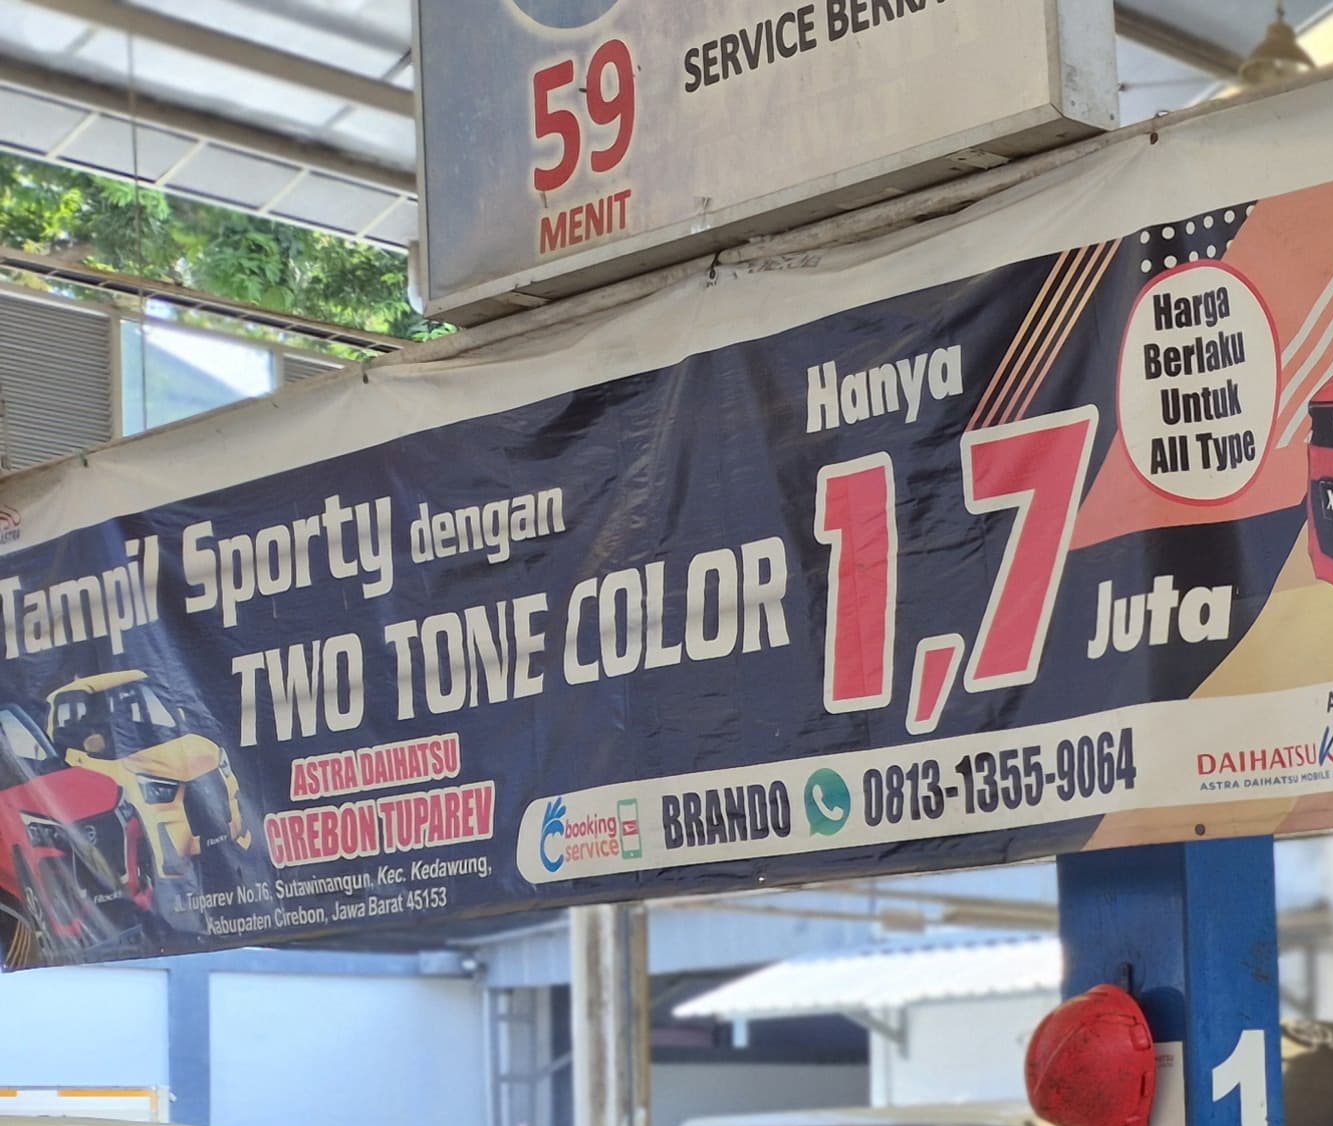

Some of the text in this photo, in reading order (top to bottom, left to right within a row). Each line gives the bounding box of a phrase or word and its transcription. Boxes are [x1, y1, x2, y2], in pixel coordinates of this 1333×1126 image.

[684, 0, 946, 93] SERVICE BER
[533, 39, 635, 191] 59
[539, 189, 632, 254] MENIT
[1153, 287, 1230, 331] Harga
[1143, 331, 1245, 380] Berlaku
[805, 344, 964, 433] Hanya
[1160, 379, 1242, 425] Untuk
[1150, 430, 1256, 475] All Type
[0, 487, 567, 660] Tampil Sporty dengan
[814, 404, 1099, 736] 1,7
[231, 535, 792, 747] TWO TONE COLOR
[1087, 575, 1232, 660] Juta
[292, 737, 458, 798] ASTRA DAIHATSU
[662, 727, 1137, 850] BRANDO 0813-1355-9064
[1197, 744, 1316, 775] DAIHATSU
[1200, 780, 1240, 791] ASTRA
[1244, 775, 1299, 787] DAIHATSU
[1301, 771, 1330, 782] MOBILE
[266, 786, 492, 866] CIREBON TUPAREV
[564, 813, 617, 840] booking
[565, 839, 620, 863] service
[187, 890, 233, 913] Tuparev
[378, 864, 406, 885] Kec.
[411, 856, 492, 880] Kedawung,
[206, 887, 447, 936] Kabupaten Cirebon, Jawa Barat 45153
